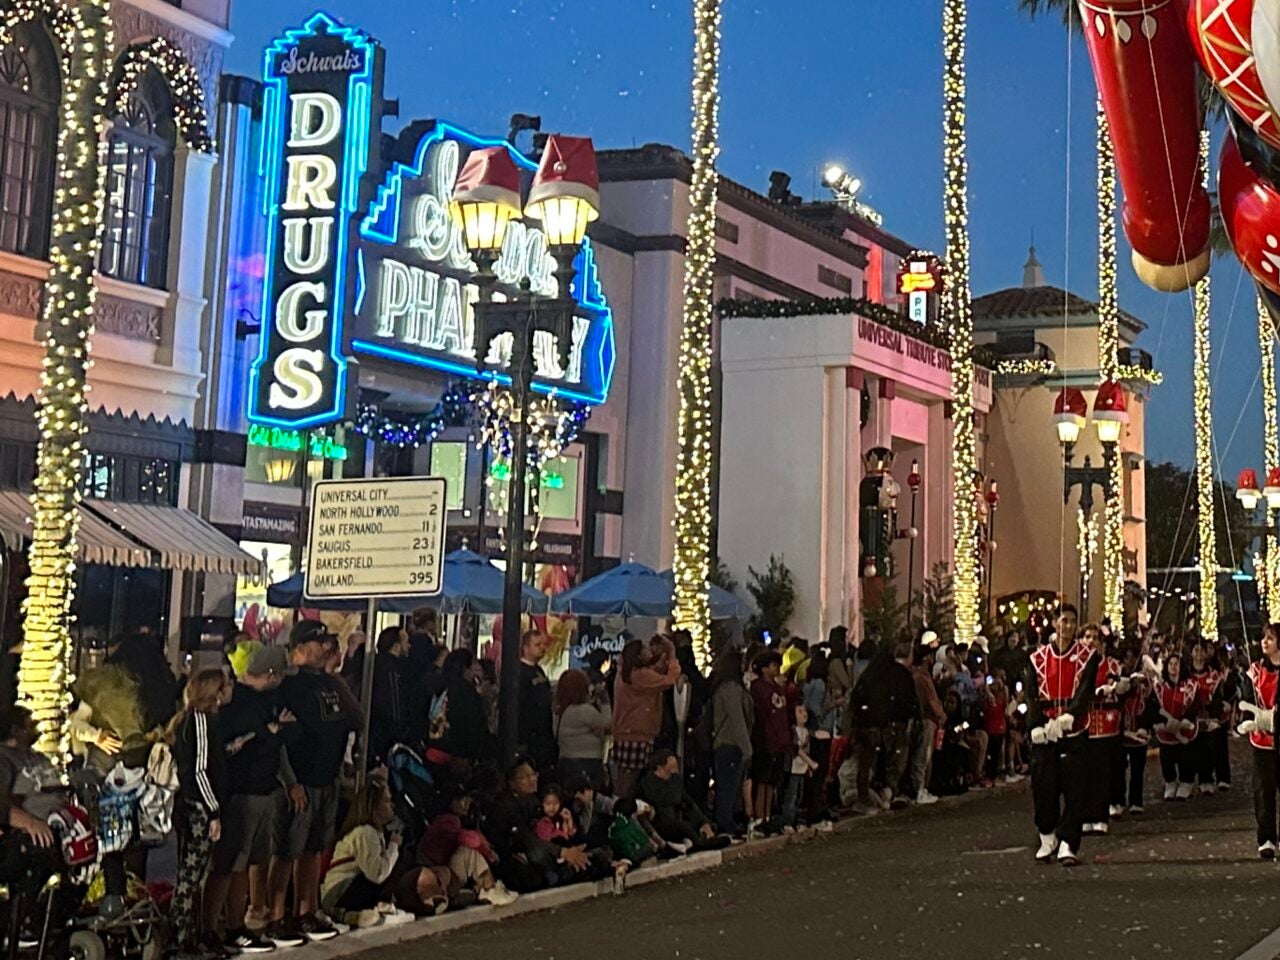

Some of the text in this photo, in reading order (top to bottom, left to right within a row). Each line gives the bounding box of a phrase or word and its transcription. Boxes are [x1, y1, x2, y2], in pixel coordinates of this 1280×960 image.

[280, 46, 361, 74] Schwab's
[268, 91, 342, 411] DRUGS
[376, 257, 590, 384] PHAY
[858, 317, 953, 373] UNIVERSAL TRIBUTE STO
[320, 489, 389, 503] UNIVERSAL CITY
[319, 504, 438, 519] NORTH HOLLYWOOD 2
[318, 524, 335, 536] SAN
[338, 522, 383, 535] FERNANDO
[317, 540, 351, 553] SAUGUS
[316, 554, 434, 570] BAKERSFIELD 113
[314, 572, 433, 588] OAKLAND 395
[573, 634, 624, 659] Schwab
